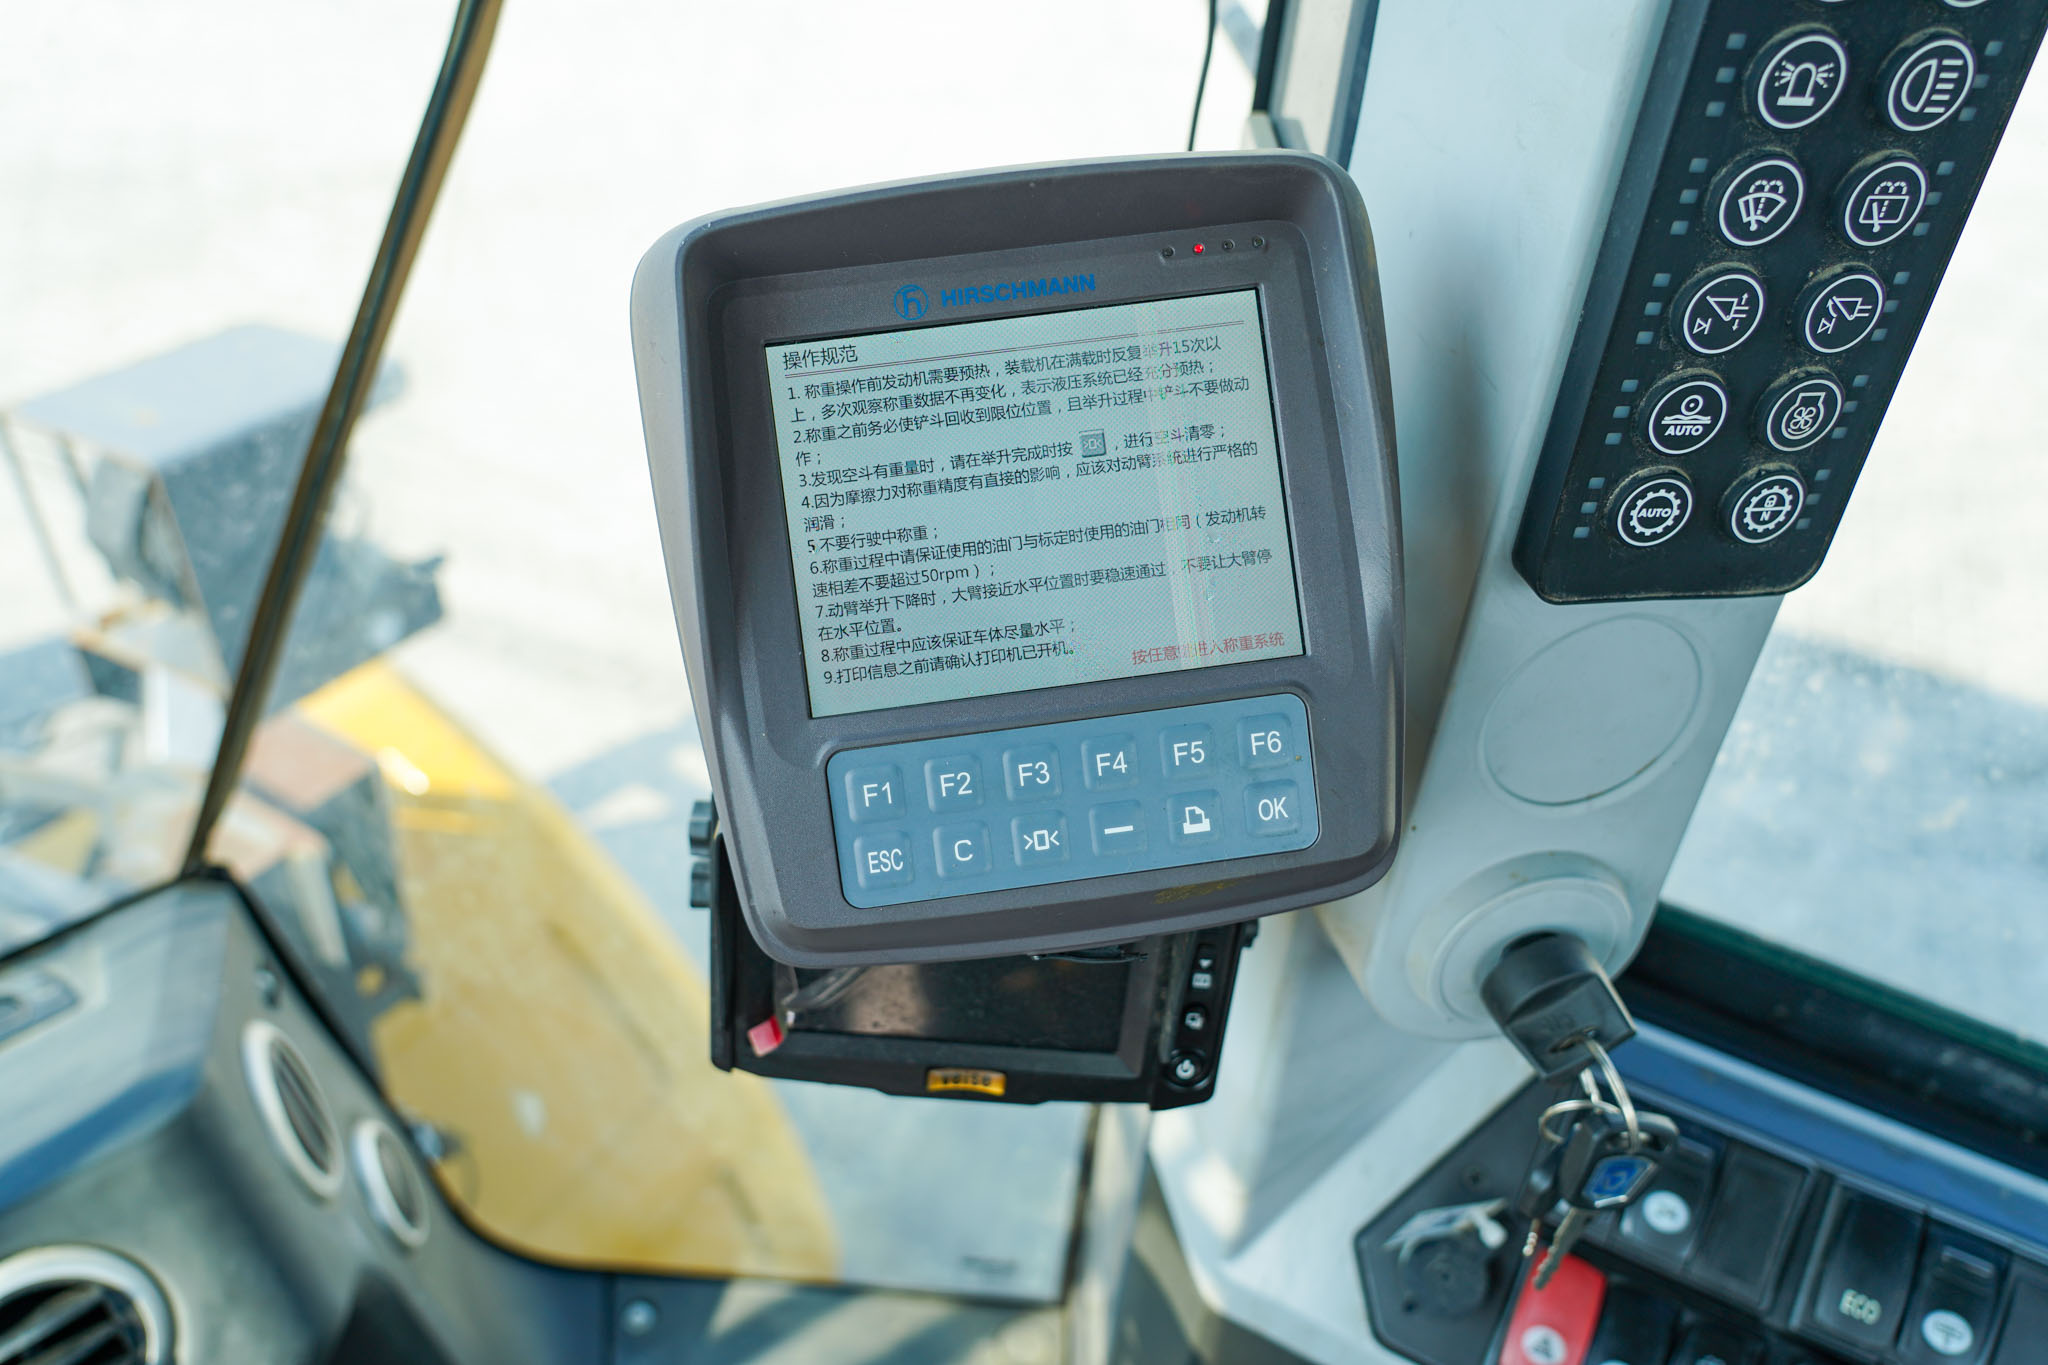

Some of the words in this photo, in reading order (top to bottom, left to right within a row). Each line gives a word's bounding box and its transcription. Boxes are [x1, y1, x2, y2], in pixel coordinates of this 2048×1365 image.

[941, 274, 1096, 308] HIRSCHMANN
[780, 344, 858, 371] 操作规范
[1664, 425, 1703, 436] AUTO
[801, 513, 846, 533] 润滑；
[1638, 507, 1672, 518] AUTO
[1760, 511, 1772, 521] N
[805, 524, 939, 554] 5不要行驶中称重；
[815, 617, 902, 642] 在水平位置。
[1173, 740, 1205, 766] F5
[1250, 730, 1282, 755] F6
[1018, 761, 1050, 787] F3
[1095, 751, 1128, 776] F4
[863, 781, 893, 807] F1
[940, 771, 973, 797] F2
[1258, 796, 1289, 821] OK
[868, 847, 904, 874] ESC
[954, 839, 974, 862] C
[1840, 1289, 1881, 1325] ECO
